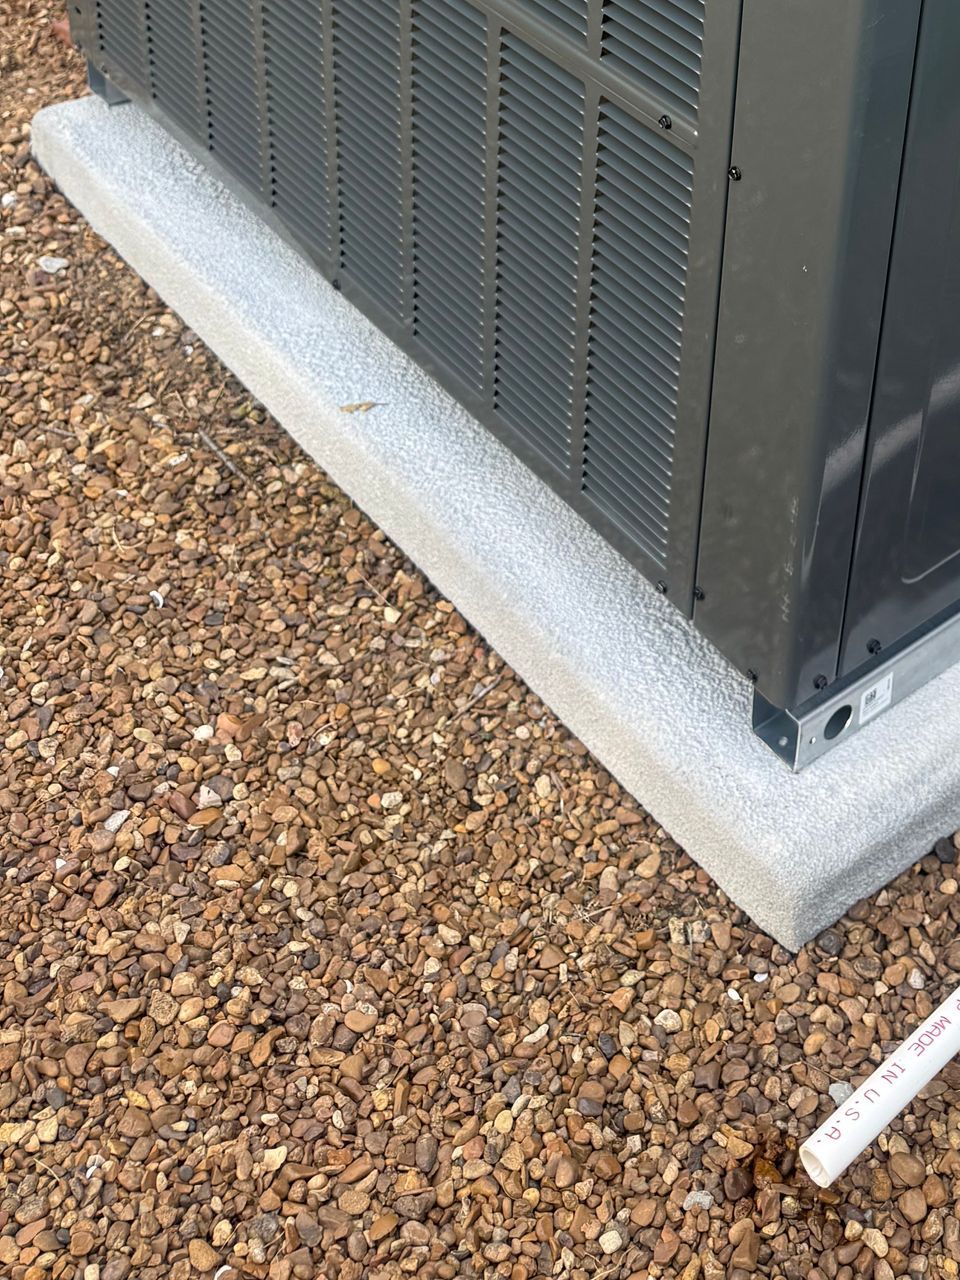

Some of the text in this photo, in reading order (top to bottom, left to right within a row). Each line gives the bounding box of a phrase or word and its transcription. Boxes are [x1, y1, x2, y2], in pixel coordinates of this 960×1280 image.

[907, 1016, 952, 1057] MADE
[881, 1063, 906, 1084] IN
[817, 1089, 880, 1143] U.S.A.
